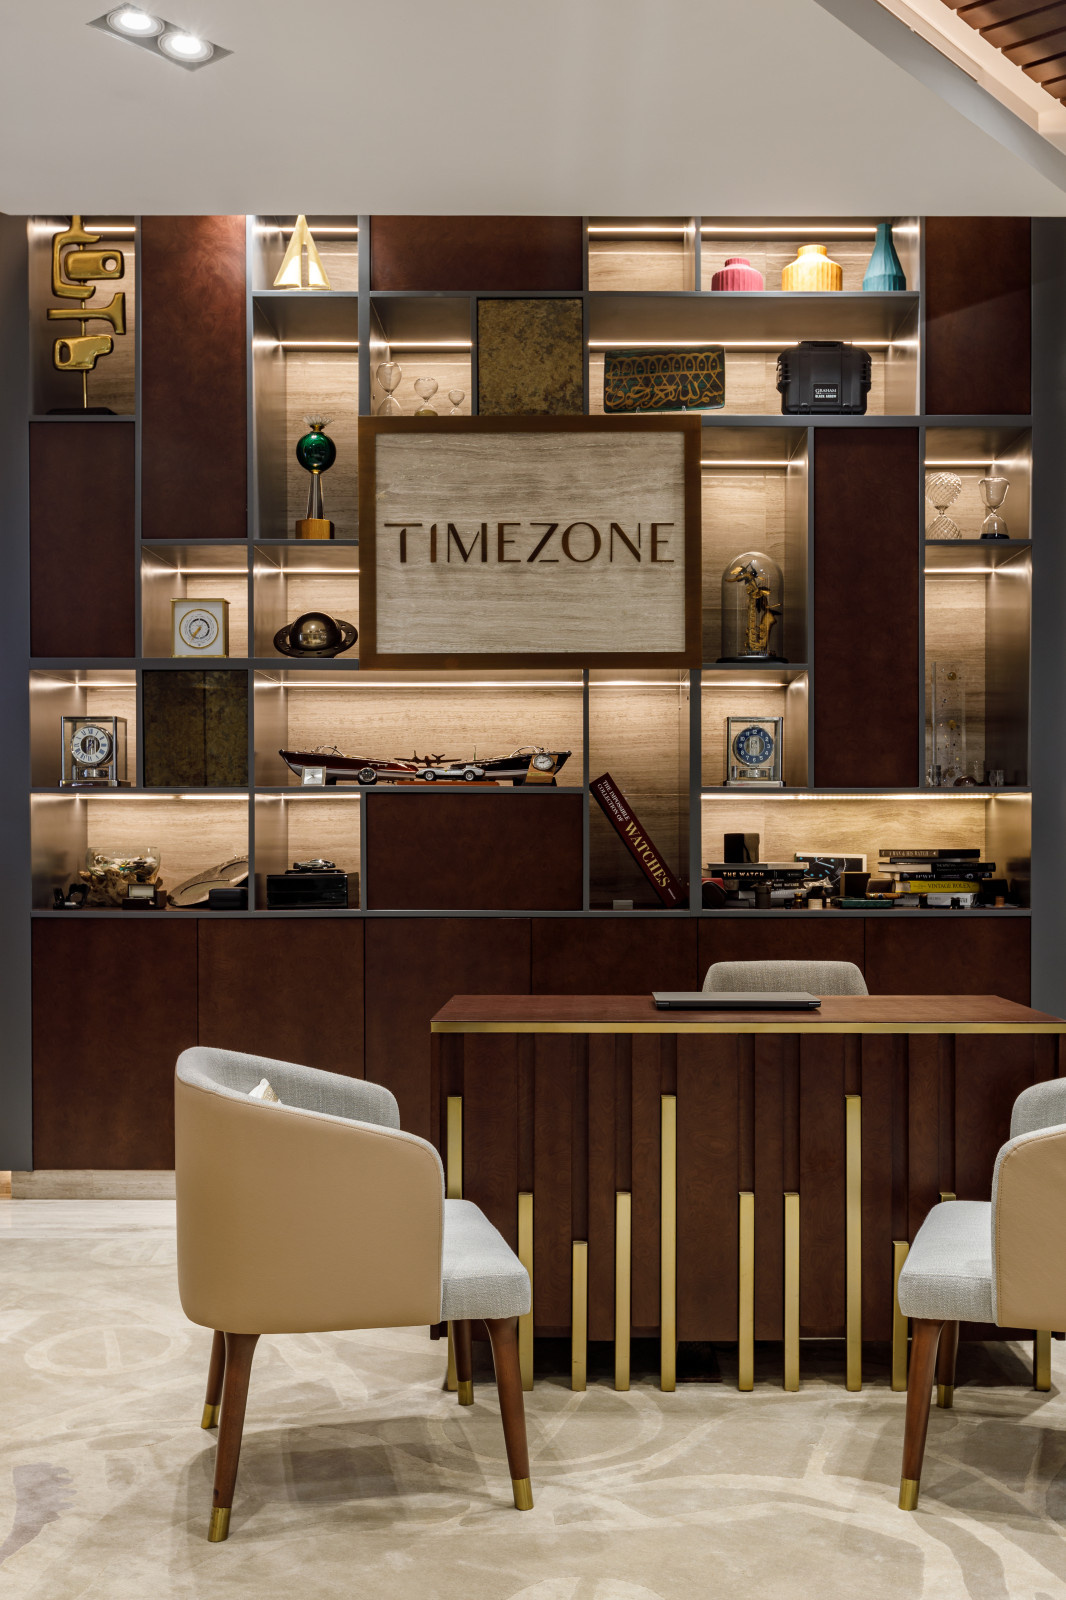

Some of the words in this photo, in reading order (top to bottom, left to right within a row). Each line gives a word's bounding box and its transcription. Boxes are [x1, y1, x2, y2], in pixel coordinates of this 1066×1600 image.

[384, 522, 674, 563] TIMEZONE
[597, 784, 619, 815] COLLECTION
[603, 780, 612, 792] THE
[609, 791, 630, 821] IMPOSSIBLE
[625, 821, 670, 887] WATCHES
